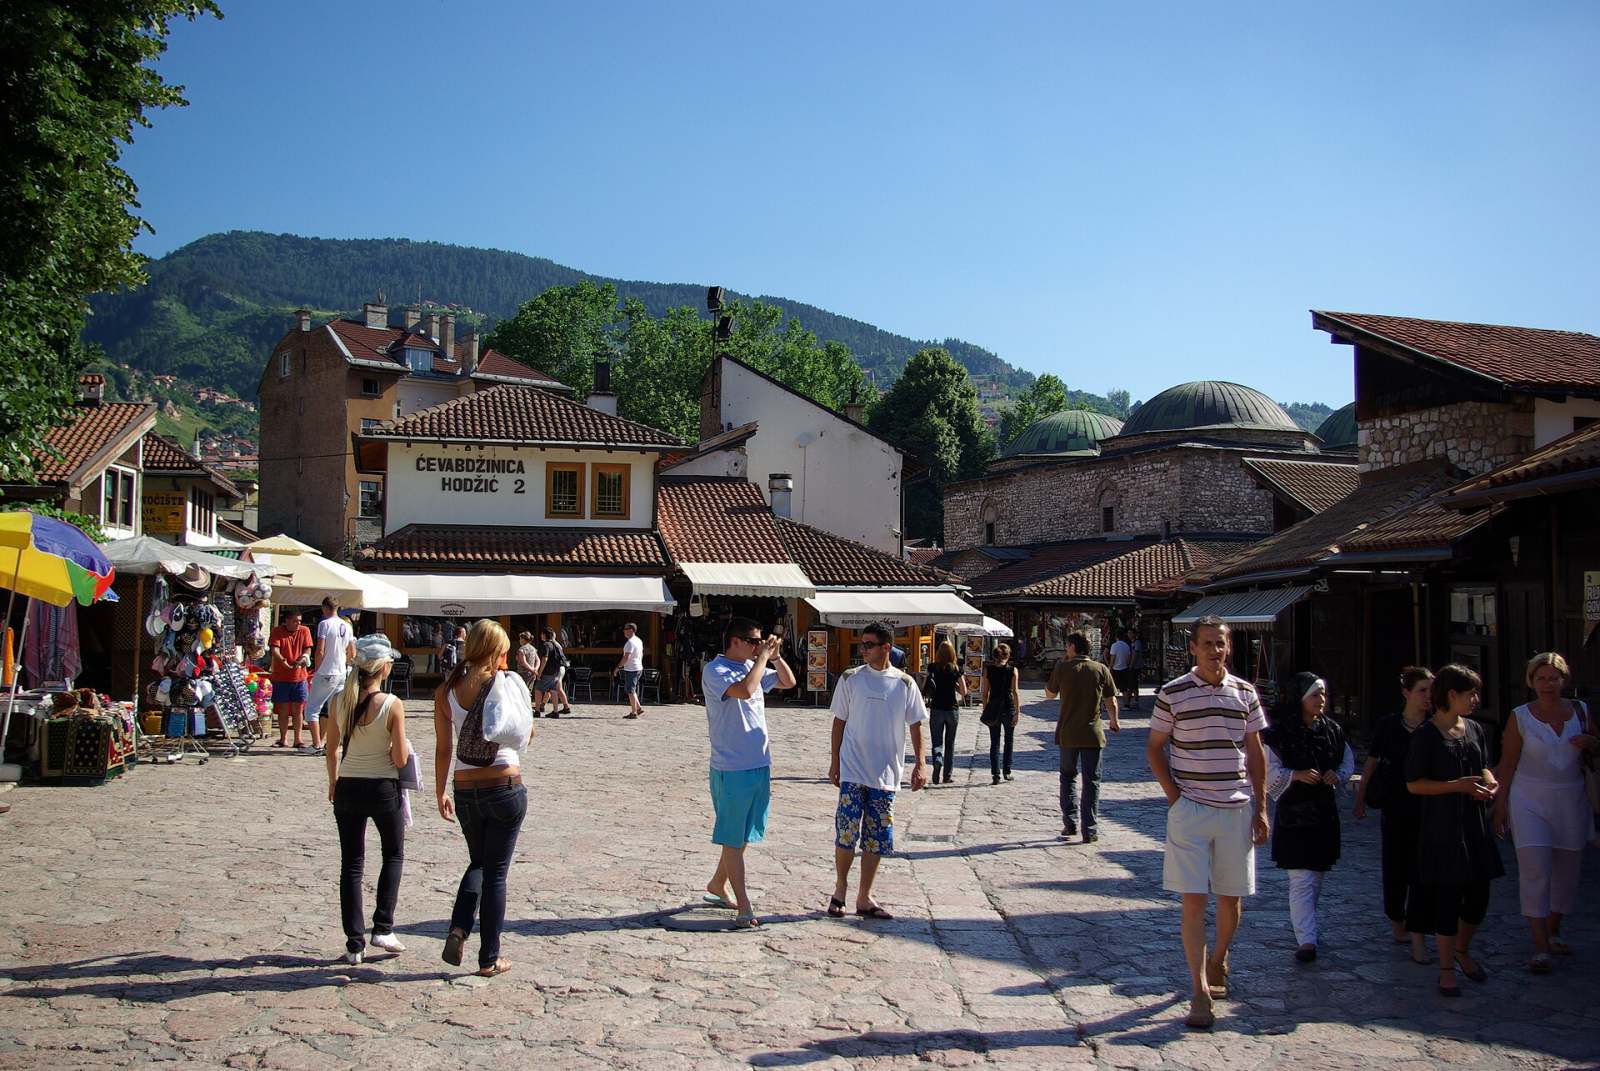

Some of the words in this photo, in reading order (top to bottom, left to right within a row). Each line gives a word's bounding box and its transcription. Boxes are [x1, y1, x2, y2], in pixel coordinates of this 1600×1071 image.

[416, 453, 525, 474] ĆEVABDŽINICA
[441, 475, 499, 493] HODŽIĆ
[514, 479, 525, 494] 2
